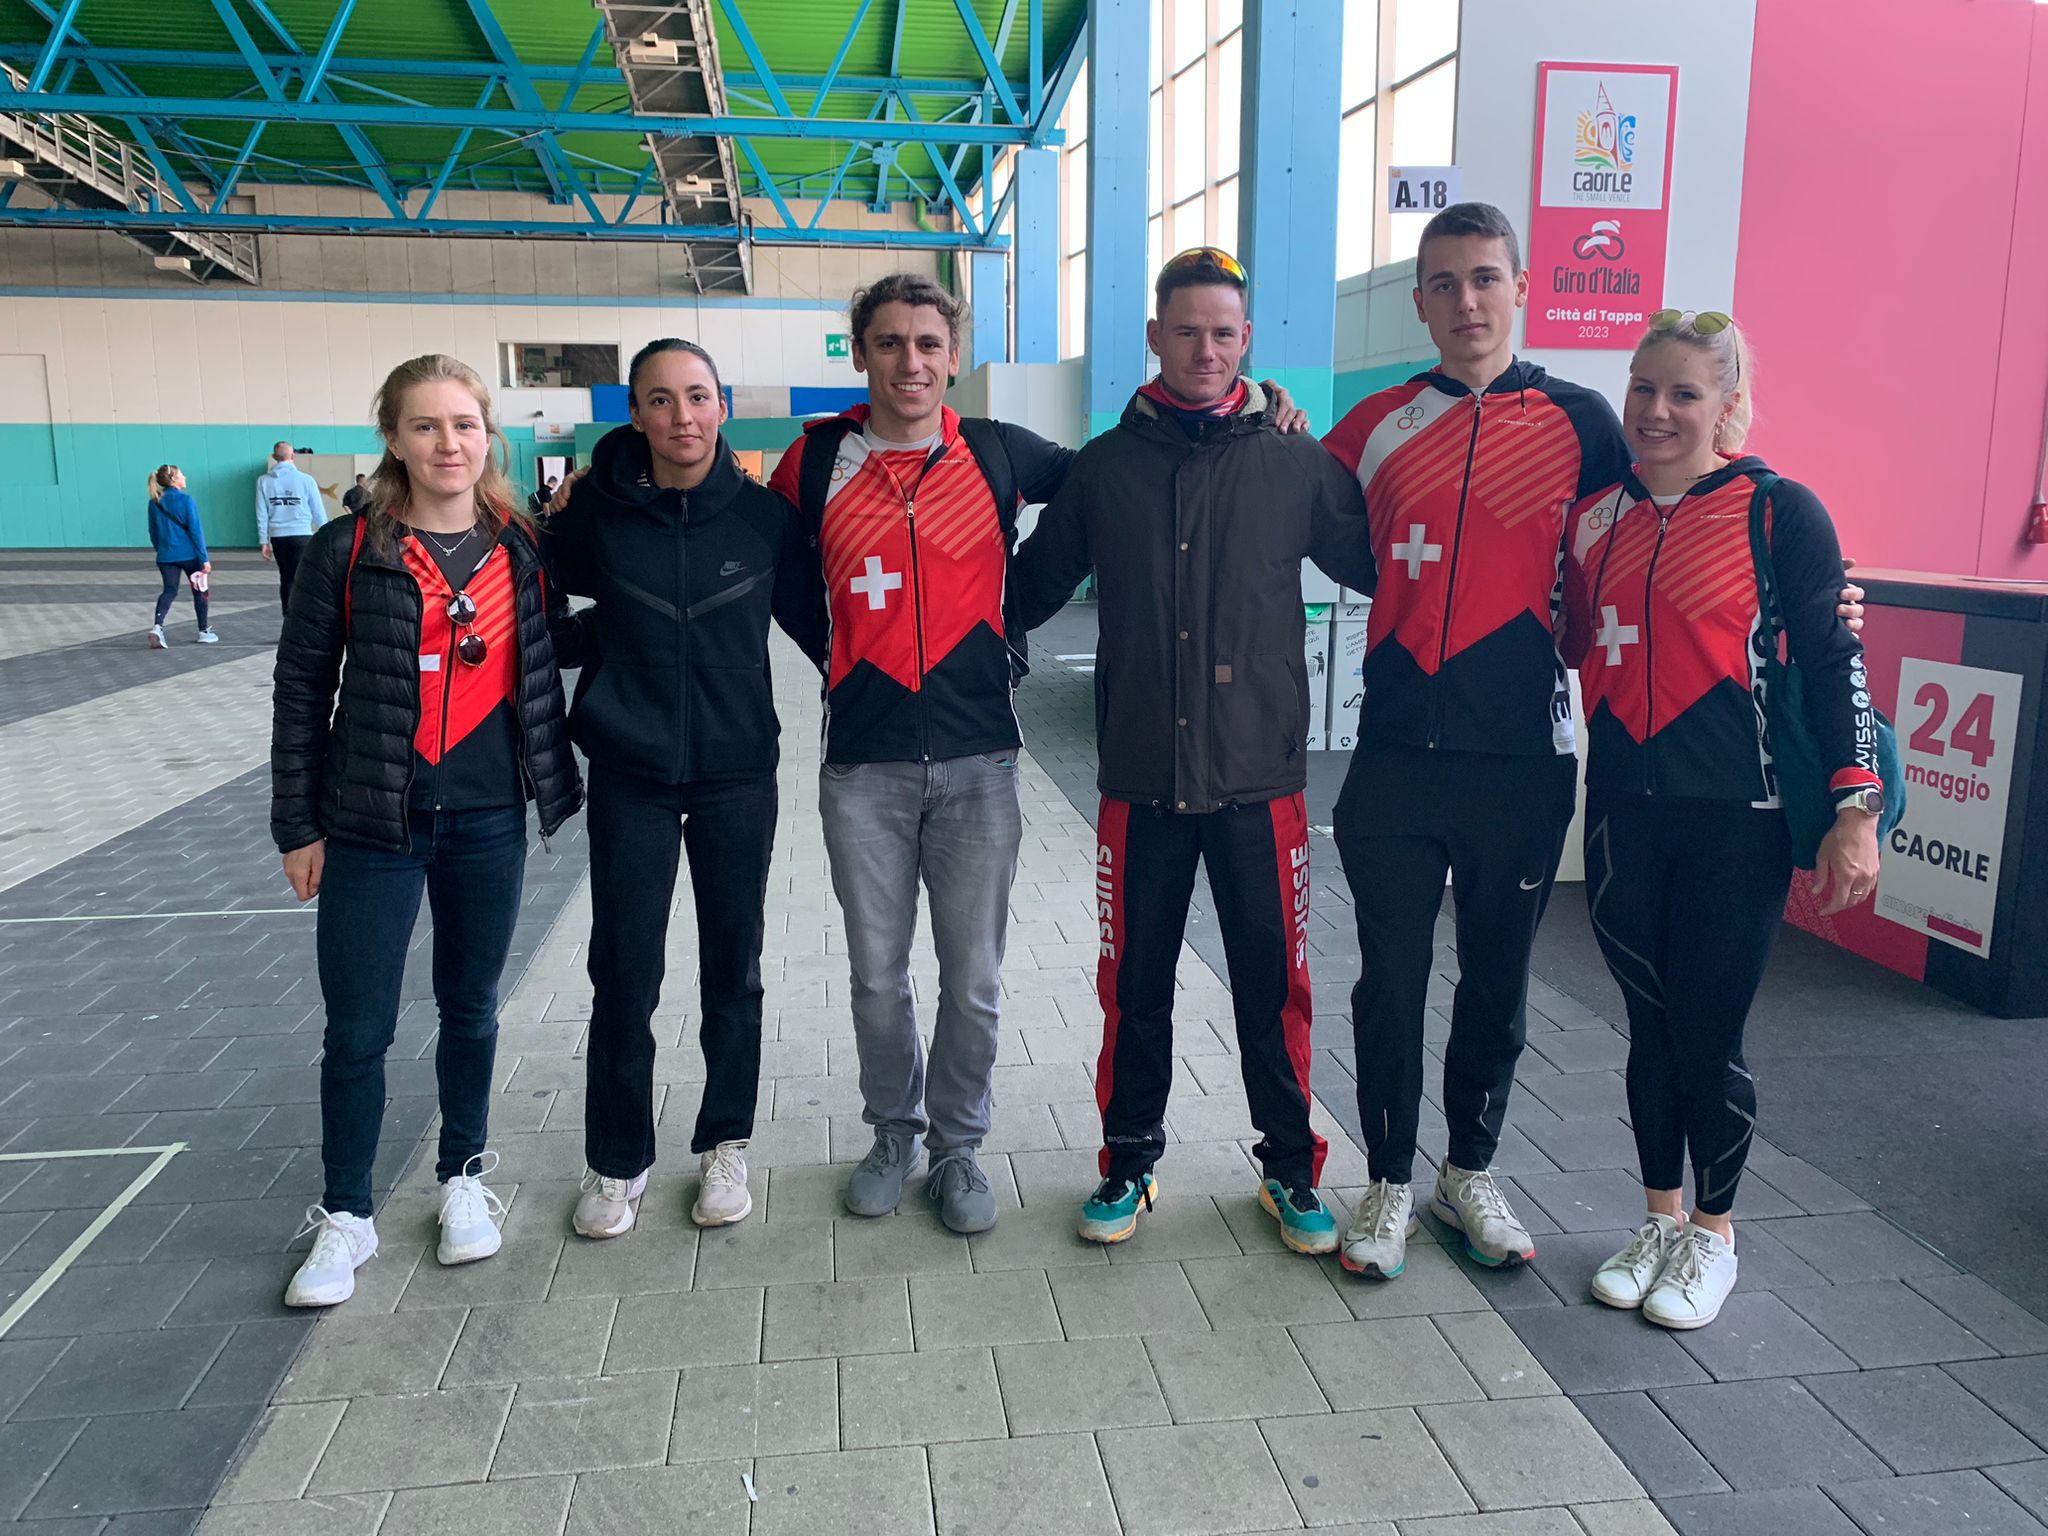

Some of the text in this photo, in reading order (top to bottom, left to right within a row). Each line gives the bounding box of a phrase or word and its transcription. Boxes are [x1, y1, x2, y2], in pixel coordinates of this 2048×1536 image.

[1395, 180, 1447, 209] A.18
[1573, 192, 1631, 202] THE SMALL VENICE
[1553, 266, 1640, 295] Giro d'Italia
[1546, 307, 1643, 326] Città di Tappa
[1578, 326, 1609, 338] 2023
[1909, 682, 1995, 768] 24
[1904, 763, 1990, 803] maggio
[1890, 829, 1990, 882] CAORLE
